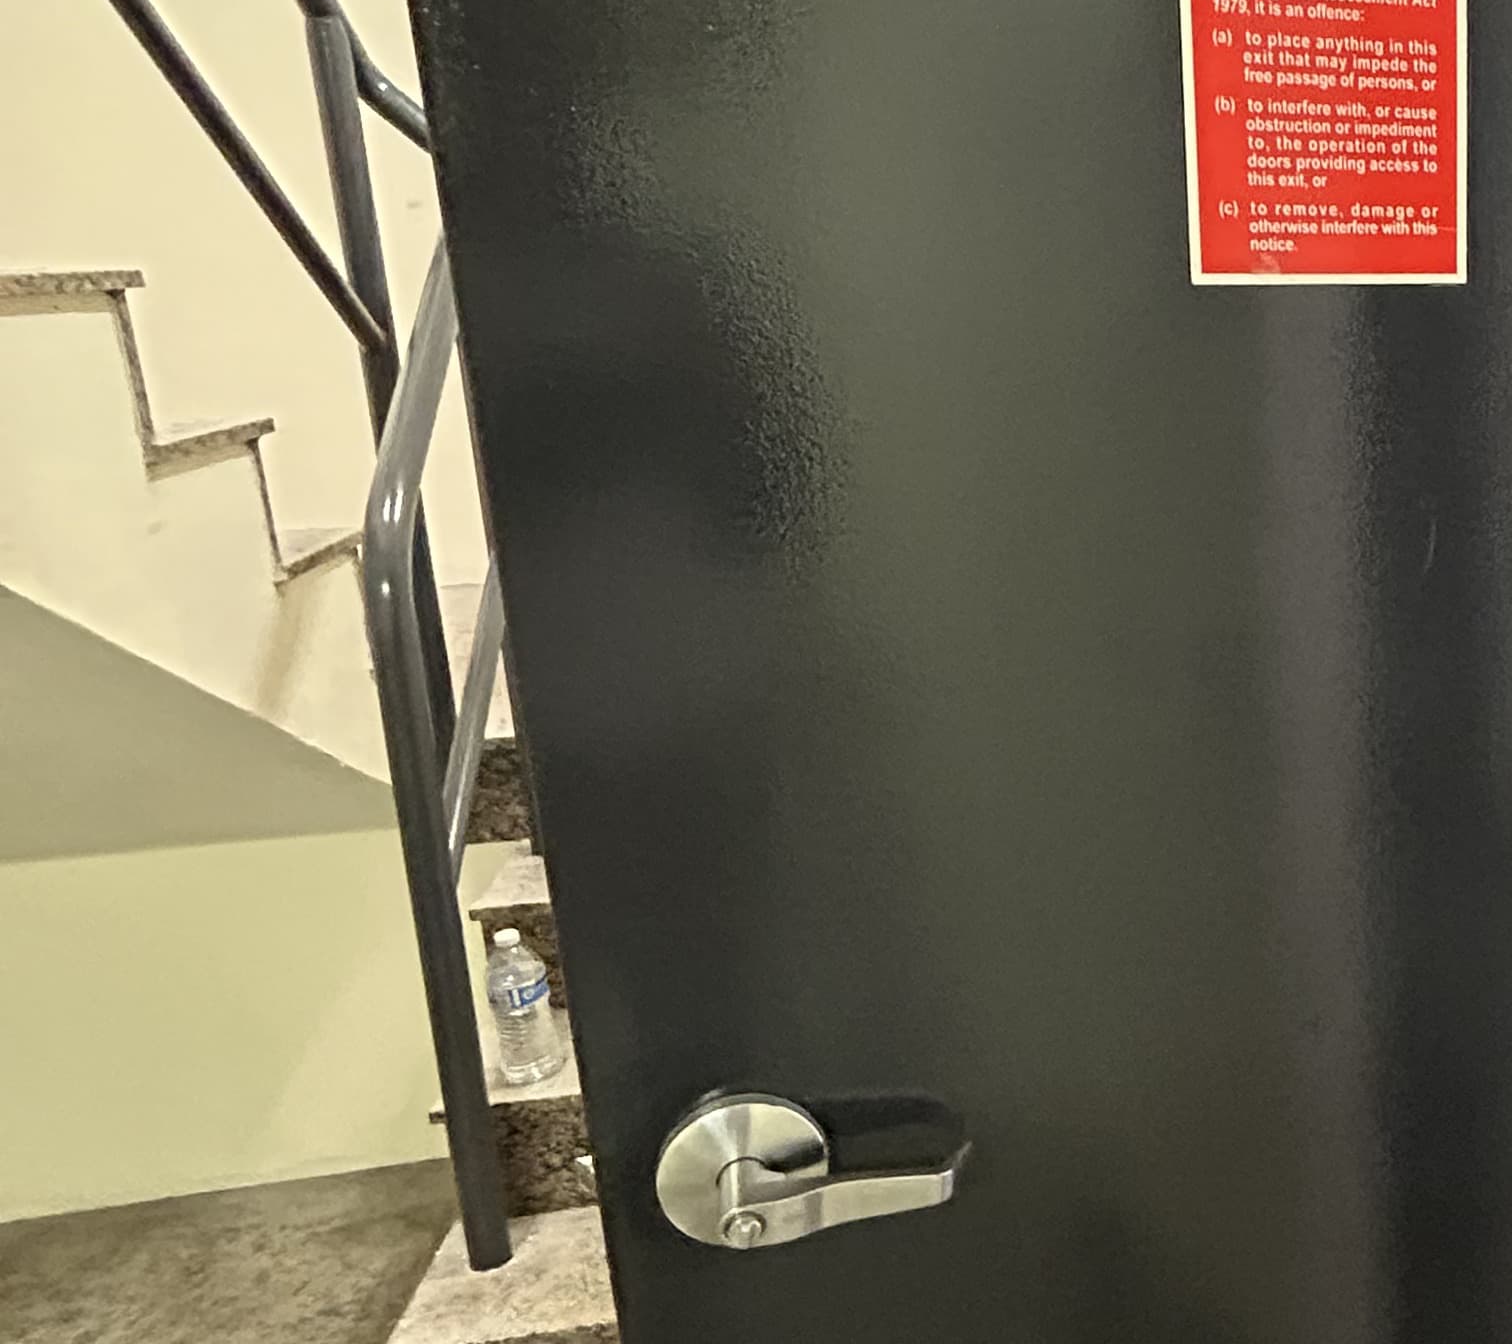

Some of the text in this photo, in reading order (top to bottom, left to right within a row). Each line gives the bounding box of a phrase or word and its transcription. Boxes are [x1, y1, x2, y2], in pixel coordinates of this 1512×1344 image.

[1255, 0, 1266, 14] it
[1268, 2, 1281, 16] is
[1285, 6, 1303, 18] an
[1307, 5, 1365, 21] offence:
[1212, 29, 1437, 55] (a) to place anything in this
[1243, 50, 1437, 74] exit that may impede the
[1245, 69, 1436, 94] free passage of persons, or
[1215, 97, 1235, 114] (b)
[1248, 101, 1263, 113] to
[1268, 101, 1331, 116] interfere
[1376, 107, 1390, 118] or
[1395, 108, 1437, 120] cause
[1246, 119, 1437, 140] obstruction or impediment
[1277, 137, 1302, 151] the
[1309, 140, 1385, 157] operation
[1392, 140, 1407, 154] of
[1413, 141, 1437, 155] the
[1248, 155, 1437, 174] doors providing access to
[1248, 173, 1328, 188] this exit, or
[1219, 201, 1238, 218] (c)
[1250, 202, 1266, 216] to
[1351, 204, 1414, 222] damage
[1421, 206, 1438, 218] or
[1249, 220, 1437, 235] otherwise interfere with this
